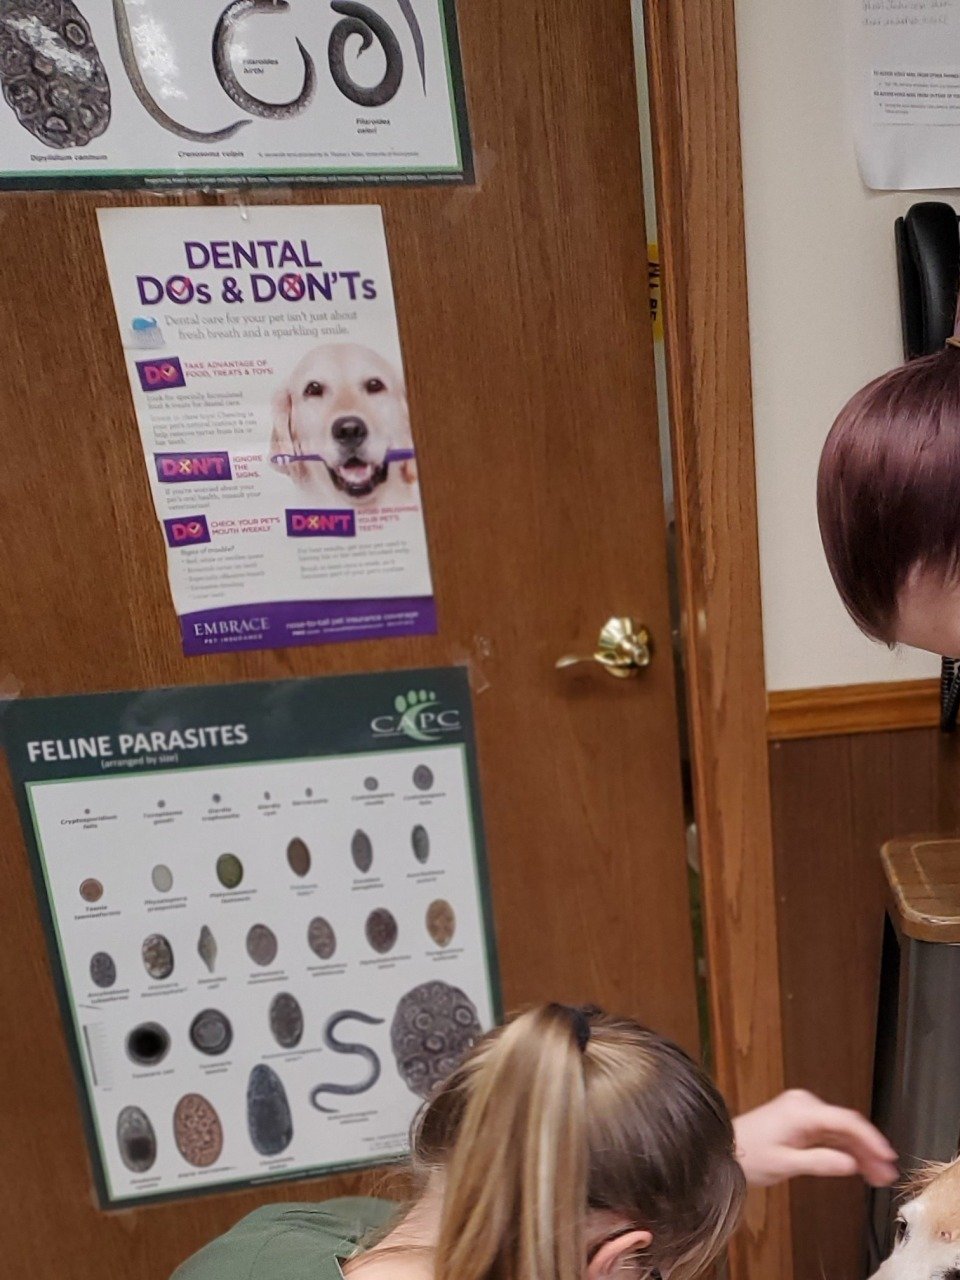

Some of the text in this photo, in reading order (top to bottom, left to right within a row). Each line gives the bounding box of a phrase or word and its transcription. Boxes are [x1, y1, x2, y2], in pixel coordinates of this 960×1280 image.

[184, 240, 322, 269] DENTAL
[136, 271, 378, 305] DOs & DON'Ts
[165, 310, 357, 326] Dental care for your pet isn't just about
[178, 328, 204, 340] fresh
[207, 327, 240, 339] breath
[243, 326, 261, 337] and
[272, 324, 318, 338] sparkling
[321, 323, 349, 335] smile.
[207, 360, 254, 368] ADVANTAGE
[144, 363, 179, 385] DO
[233, 454, 263, 462] IGNORE
[162, 457, 225, 477] DON'T
[211, 516, 281, 528] CHECK YOUR PET'S
[212, 525, 272, 536] MOUTH WEEKLY
[291, 515, 351, 531] DON'T
[171, 521, 204, 542] DO
[194, 616, 270, 637] EMBRACE
[204, 633, 263, 645] PET INSURANCE
[27, 723, 249, 762] FELINE PARASITES
[101, 753, 179, 770] (arranged by size)
